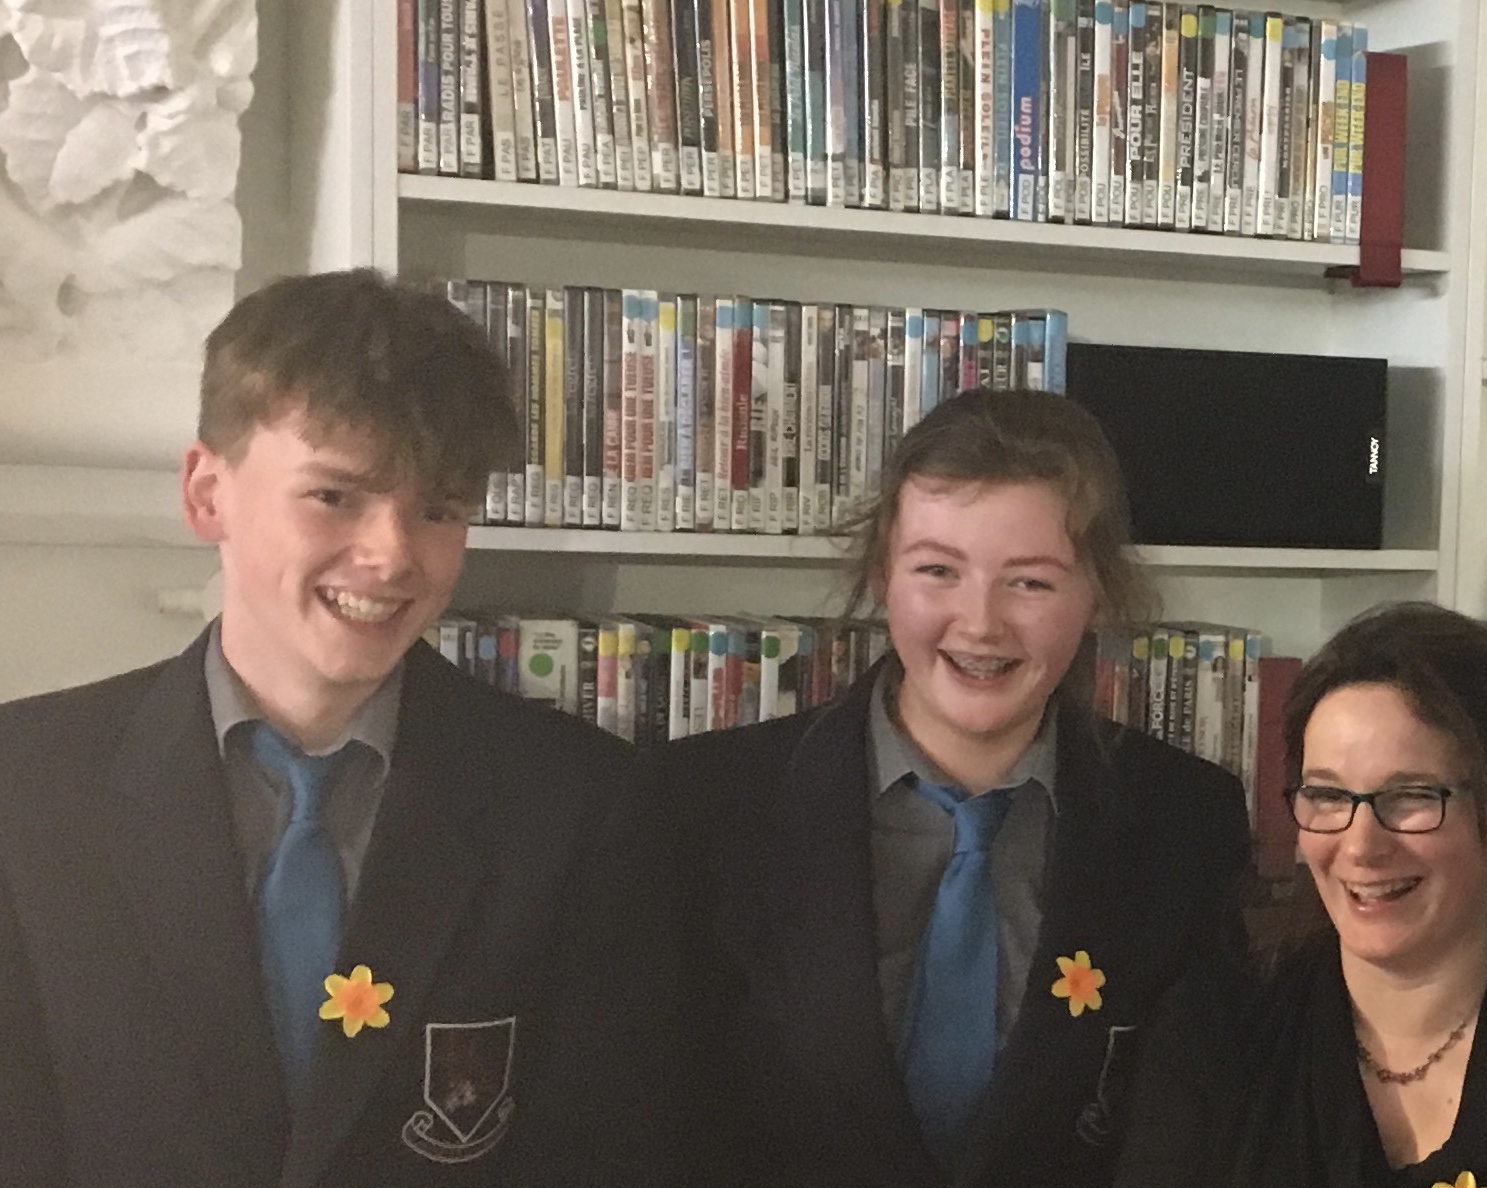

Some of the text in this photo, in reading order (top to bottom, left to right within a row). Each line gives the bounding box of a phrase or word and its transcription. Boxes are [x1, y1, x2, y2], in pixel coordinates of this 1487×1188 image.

[441, 32, 454, 70] POUR
[980, 28, 991, 84] PLEIN
[442, 75, 454, 123] RADIS
[498, 79, 510, 97] LE
[903, 62, 918, 126] PILE FACE
[1130, 51, 1143, 160] POUR ELLE
[424, 128, 435, 154] PAR
[466, 121, 477, 145] PAR
[1015, 96, 1035, 170] podium
[500, 138, 512, 164] PAS
[562, 138, 573, 163] PAU
[580, 144, 591, 168] PAU
[945, 169, 955, 192] PLA
[1020, 180, 1032, 204] POD
[1111, 180, 1122, 204] POU
[1096, 182, 1106, 207] POU
[1129, 187, 1141, 211] POU
[1144, 184, 1155, 208] POU
[1161, 185, 1173, 208] POU
[1177, 191, 1188, 213] PRE
[1194, 188, 1205, 211] PRE
[1227, 194, 1238, 217] PRE
[1318, 185, 1329, 209] PRO
[1289, 201, 1300, 225] PRO
[1333, 201, 1344, 223] PUR
[1349, 201, 1360, 224] PUR
[624, 396, 637, 417] UNE
[641, 399, 654, 419] UNE
[717, 413, 729, 426] la
[530, 421, 541, 467] EGARDE
[624, 419, 637, 450] POUR
[641, 422, 654, 453] POUR
[606, 450, 617, 465] LA
[718, 442, 730, 480] Retour
[1369, 437, 1379, 474] TANNOY
[530, 471, 541, 497] REG
[606, 484, 618, 508] REN
[660, 487, 671, 511] RES
[717, 487, 728, 510] RET
[769, 492, 779, 512] RIP
[802, 496, 811, 515] RIV
[1183, 680, 1194, 714] PARIS
